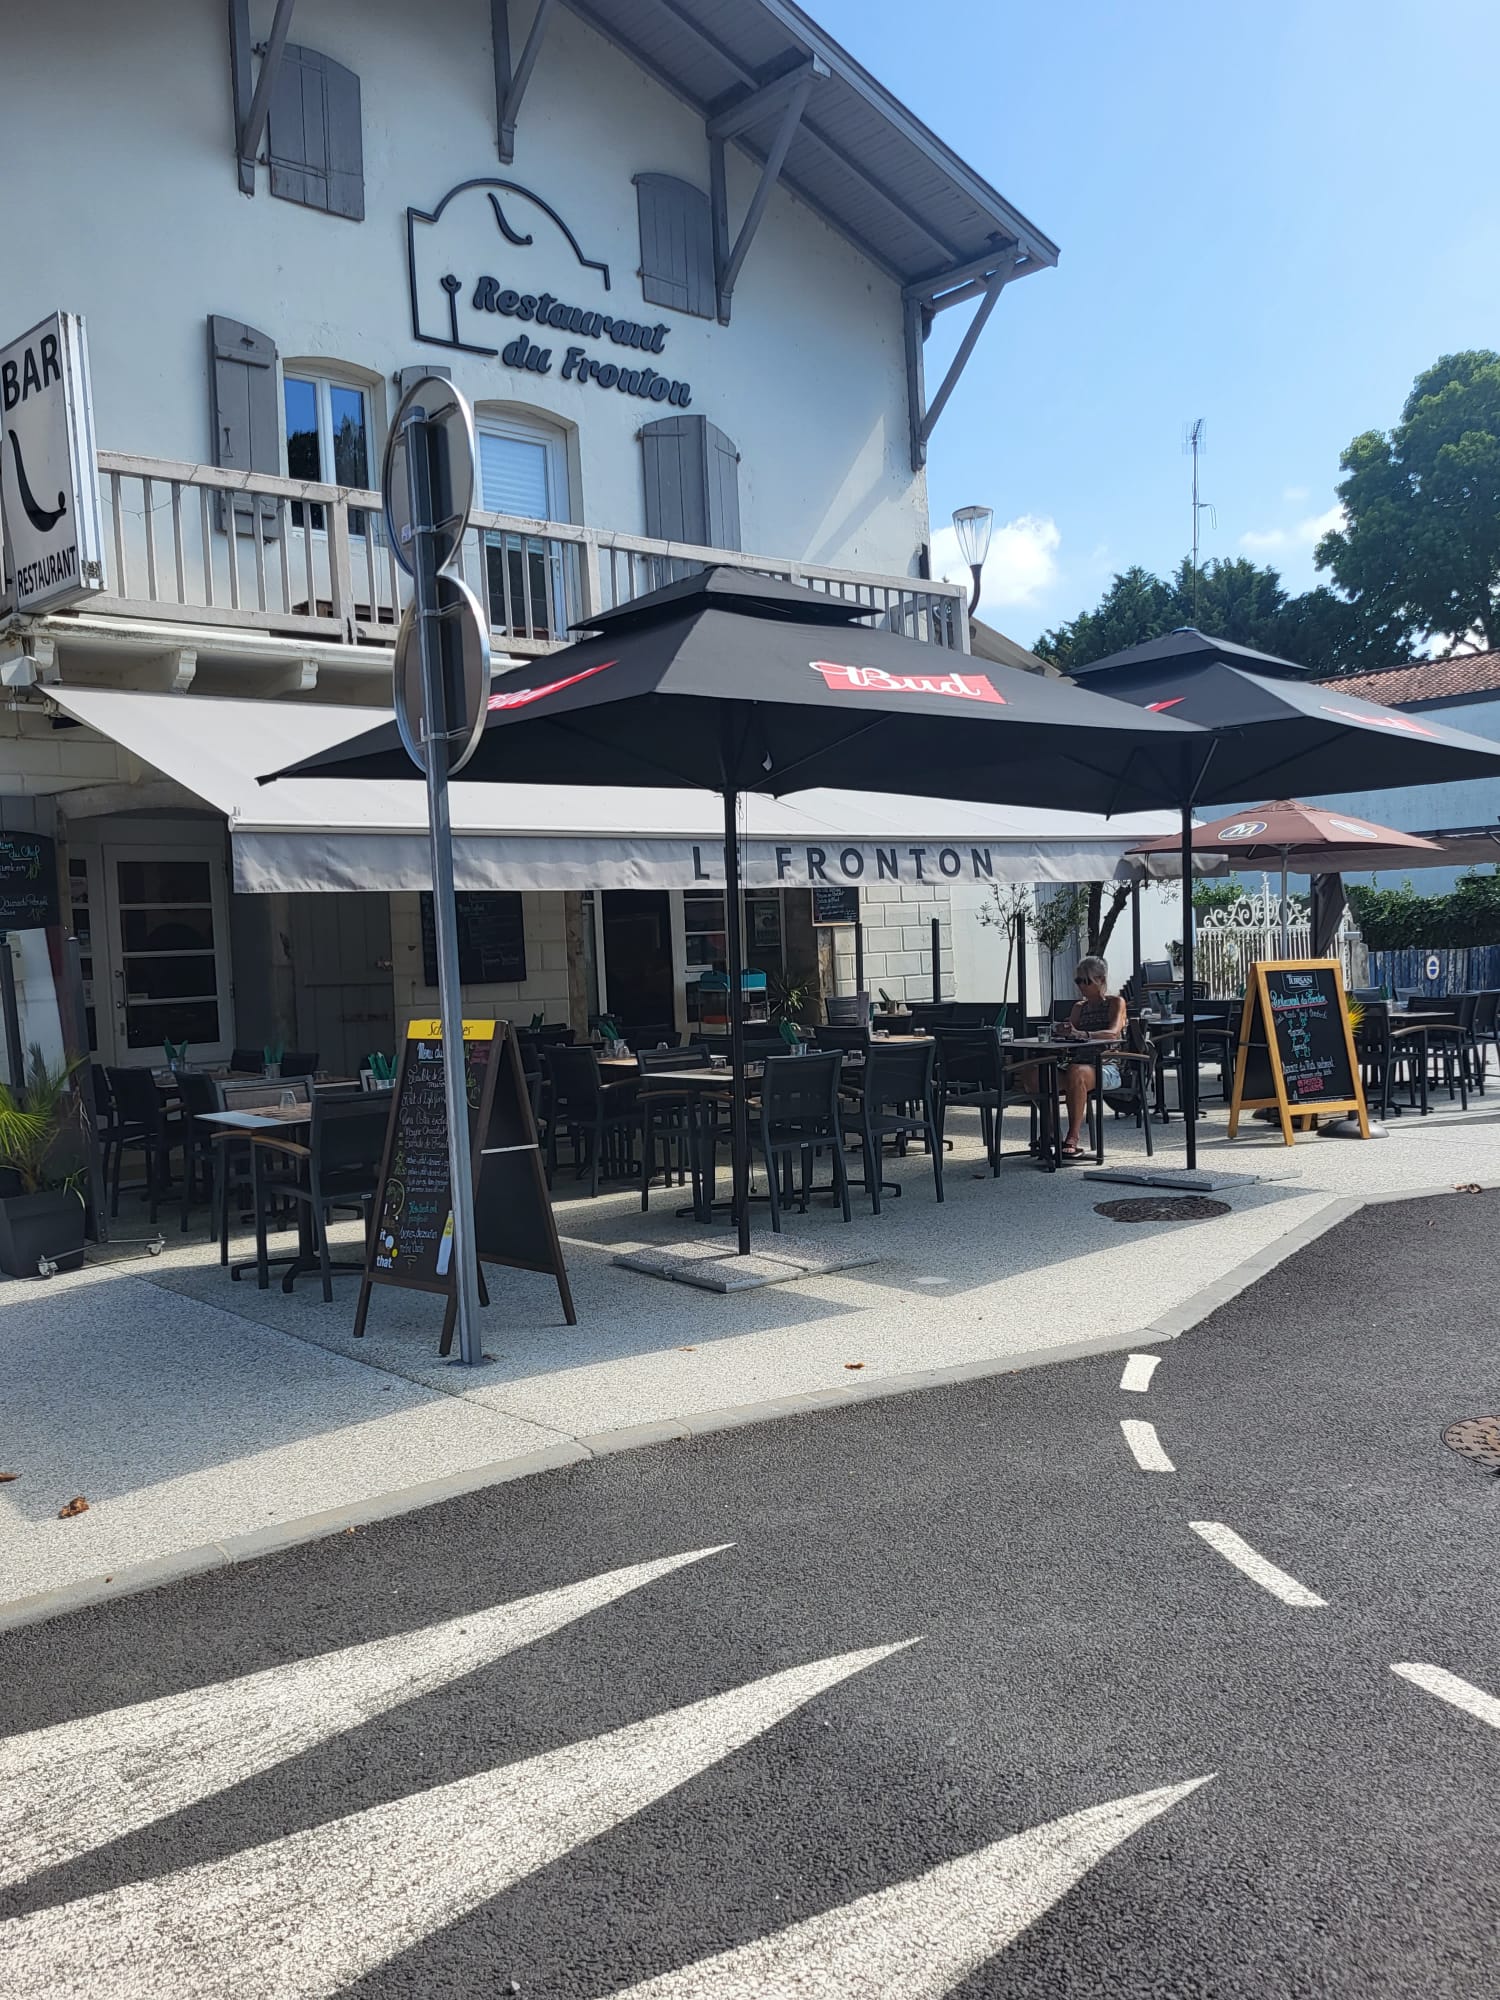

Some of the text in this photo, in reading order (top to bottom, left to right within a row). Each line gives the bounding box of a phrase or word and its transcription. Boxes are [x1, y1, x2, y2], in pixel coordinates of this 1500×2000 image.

[472, 276, 671, 354] Restaurant
[1, 333, 61, 412] BAR
[502, 334, 692, 407] du Fronton
[17, 546, 76, 599] RESTAURANT
[809, 661, 981, 697] Bud
[775, 847, 994, 881] FRONTON
